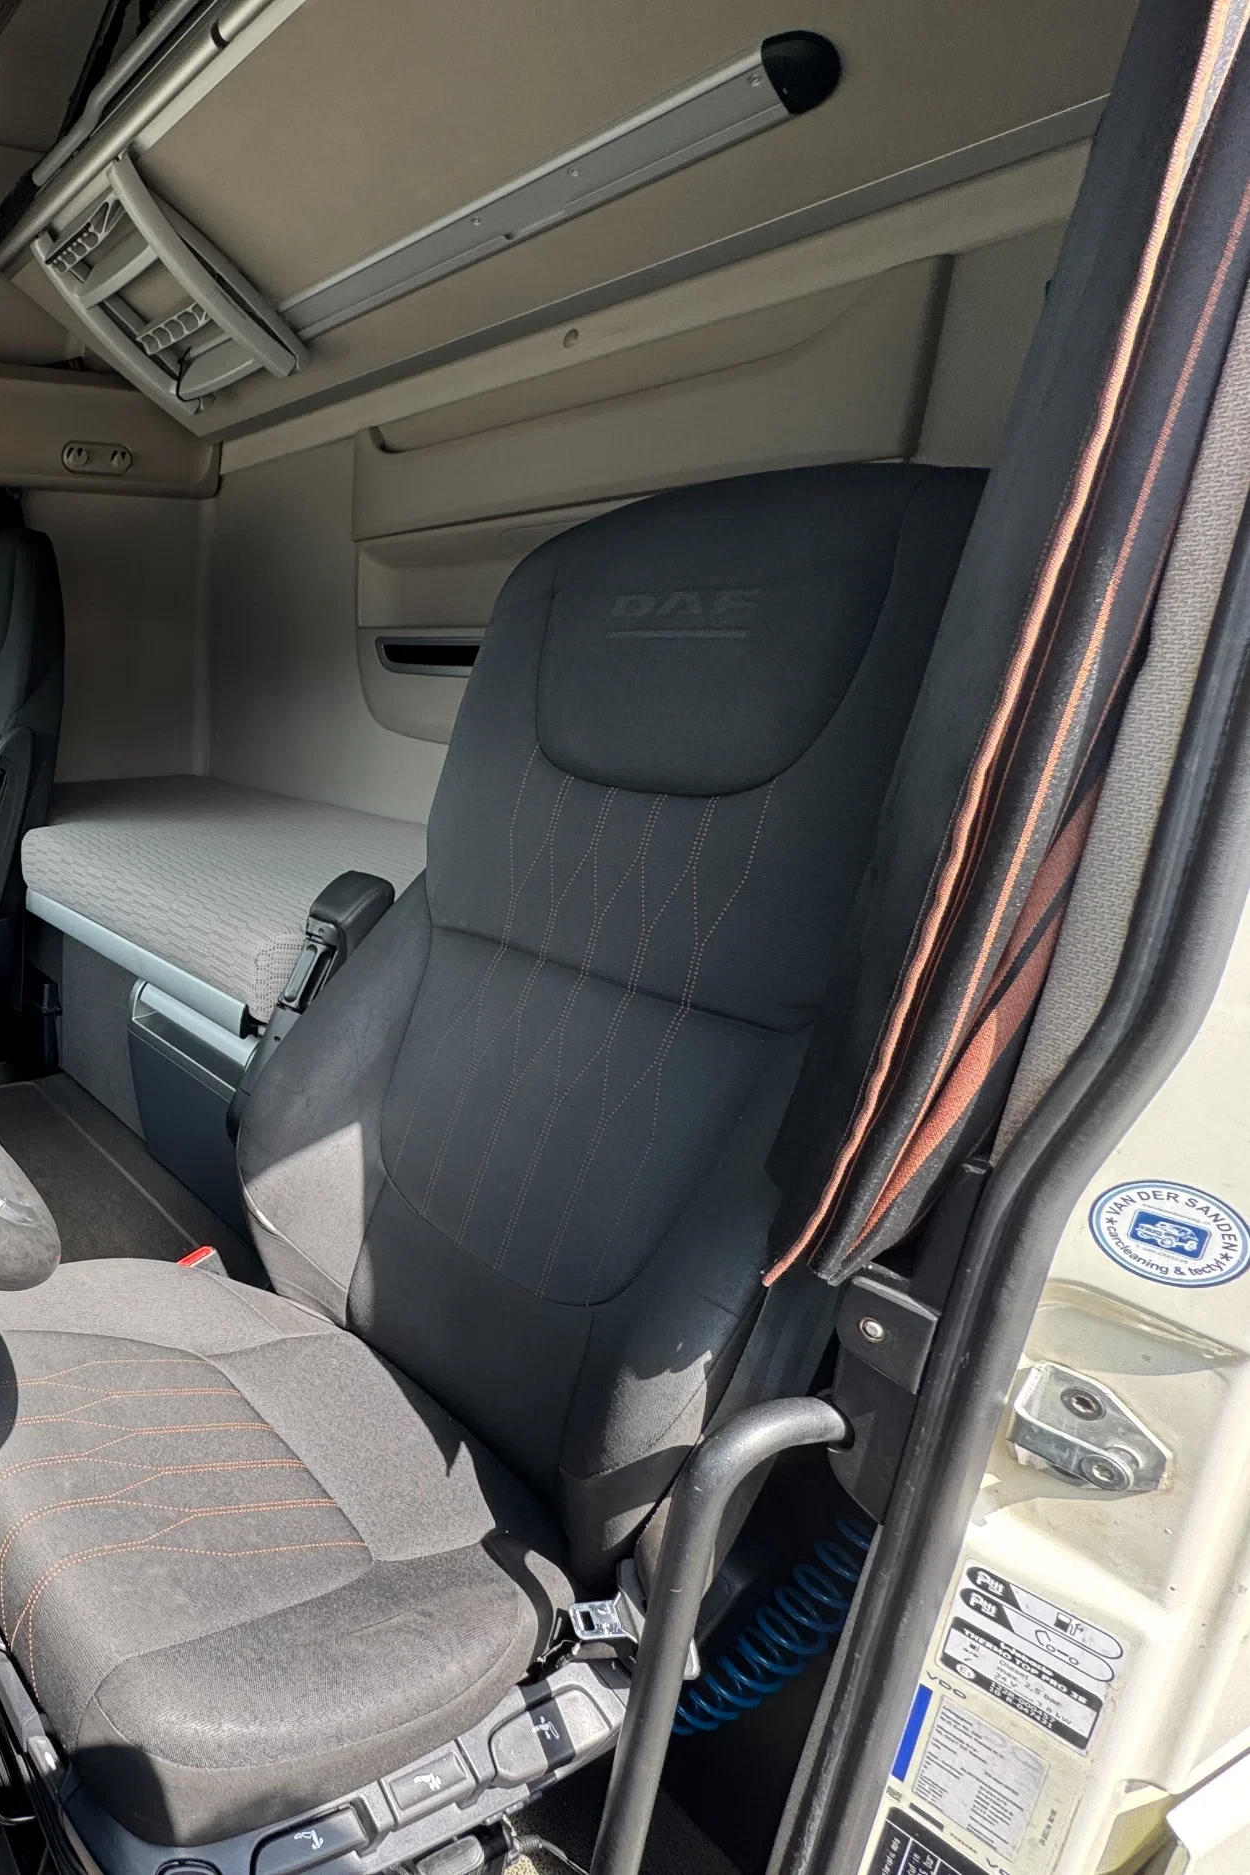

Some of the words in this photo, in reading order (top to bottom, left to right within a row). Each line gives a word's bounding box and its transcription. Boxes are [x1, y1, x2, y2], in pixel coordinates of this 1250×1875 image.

[613, 589, 761, 617] DAF
[1106, 1194, 1137, 1216] VAN
[1136, 1190, 1181, 1203] DER
[1185, 1198, 1238, 1252] SANDEN
[1106, 1226, 1169, 1275] carcleaning
[1174, 1266, 1187, 1276] &
[1188, 1258, 1227, 1276] tectyl
[963, 1628, 1013, 1661] THERMO
[1014, 1656, 1040, 1676] TOP
[1041, 1673, 1069, 1694] PRO
[999, 1659, 1029, 1681] Diesel
[926, 1670, 968, 1700] VDO
[1042, 1690, 1063, 1708] bar
